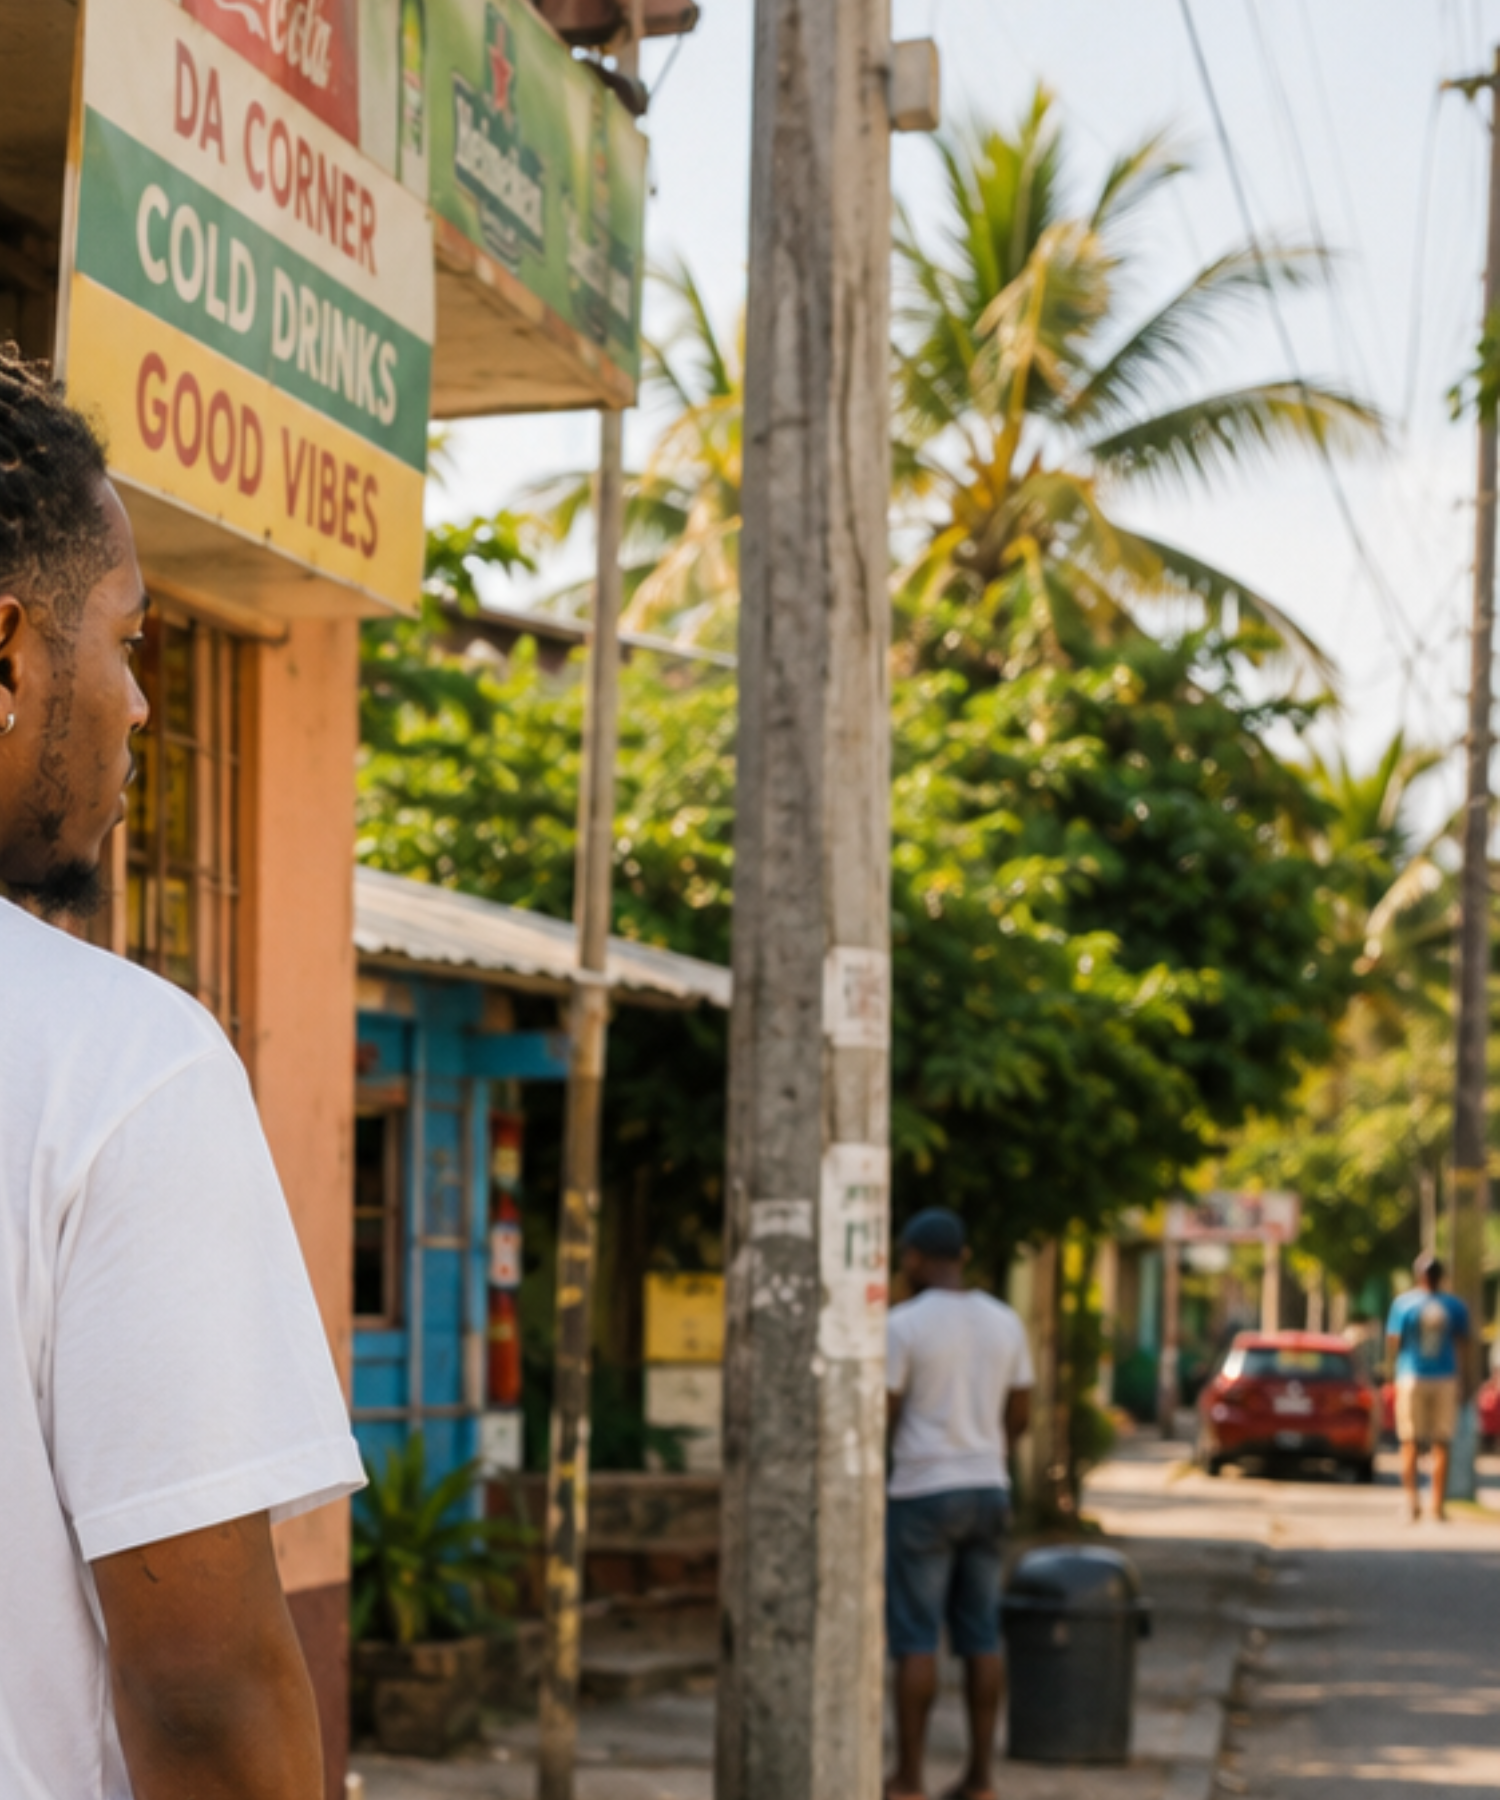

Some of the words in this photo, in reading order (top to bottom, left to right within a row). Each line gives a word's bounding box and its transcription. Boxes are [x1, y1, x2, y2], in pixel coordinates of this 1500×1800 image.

[173, 37, 226, 166] DA
[243, 99, 378, 277] CORNER
[136, 184, 257, 334] COLD
[271, 267, 397, 426] DRINKS
[136, 352, 264, 499] GOOD
[280, 426, 379, 560] VIBES
